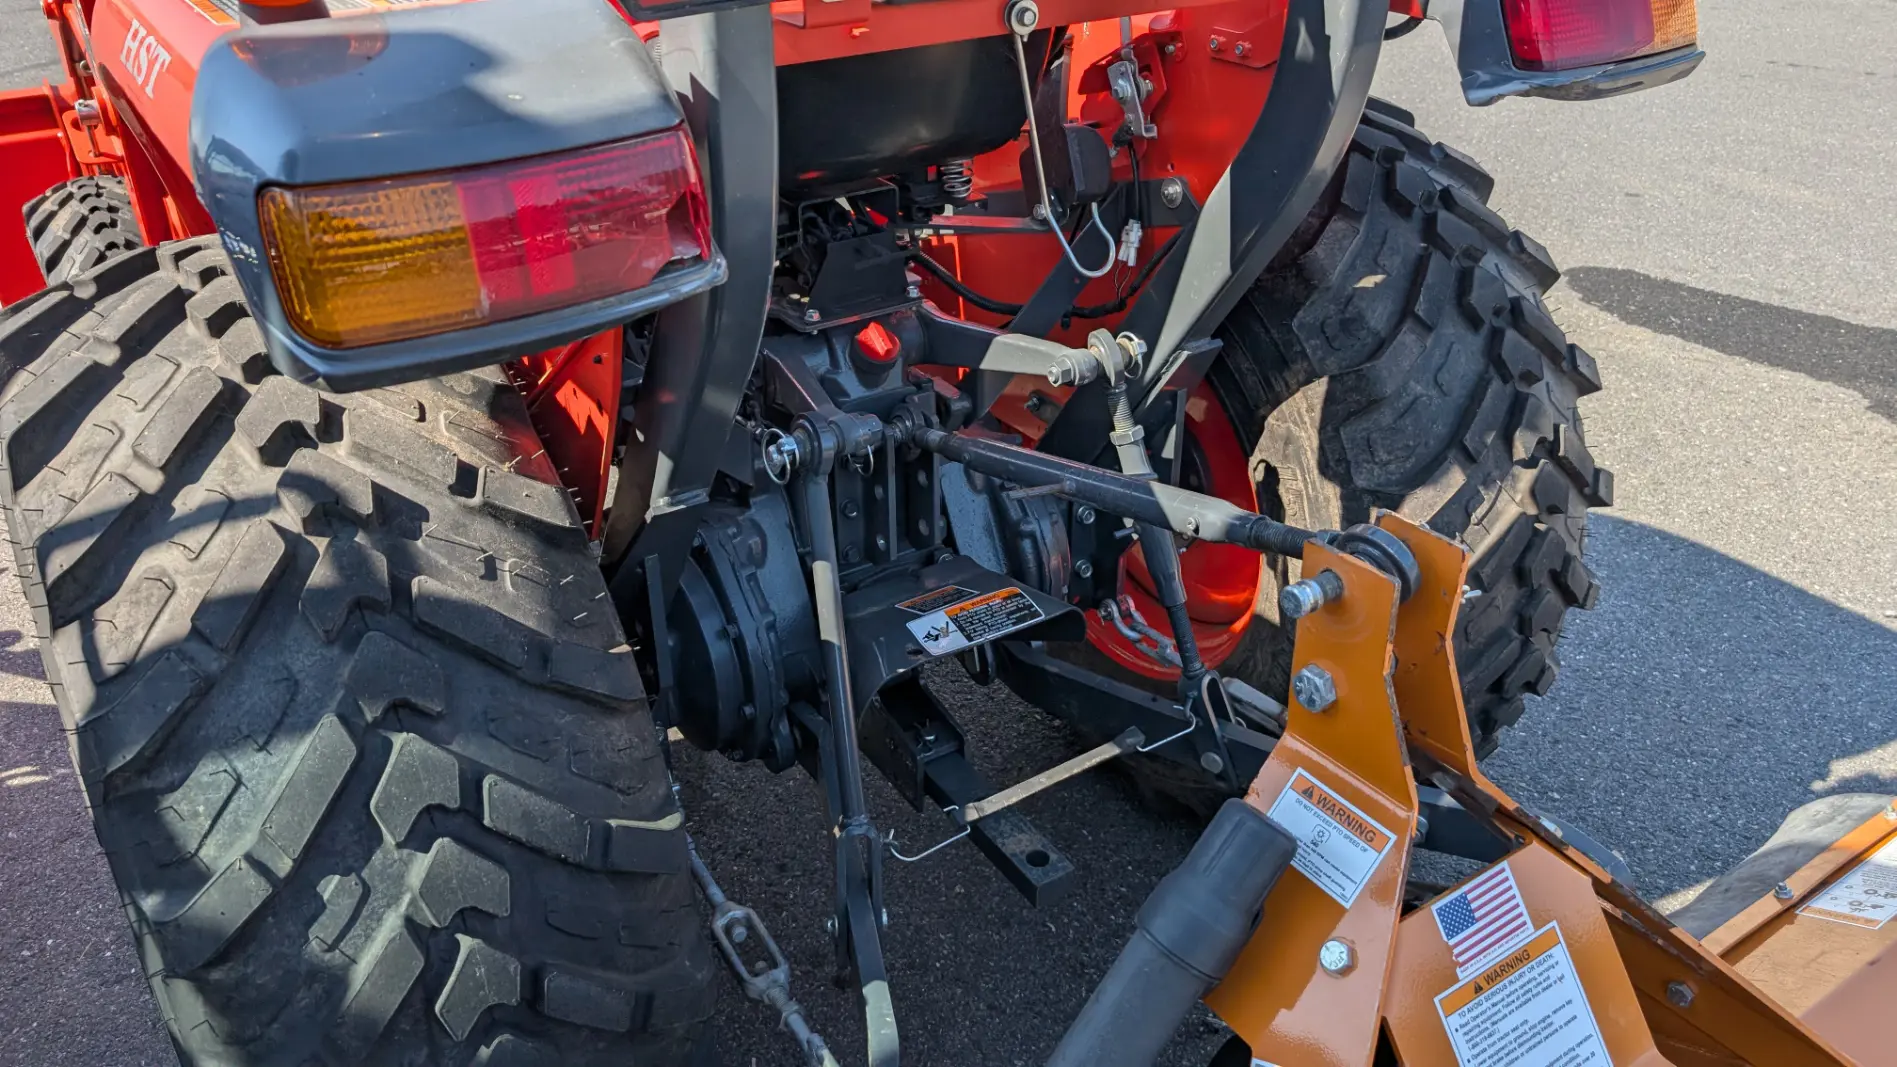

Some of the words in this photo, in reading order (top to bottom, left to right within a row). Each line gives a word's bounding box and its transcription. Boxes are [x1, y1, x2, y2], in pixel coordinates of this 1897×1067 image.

[120, 18, 172, 100] HST
[970, 592, 1000, 607] WARNING
[1294, 797, 1303, 806] DO
[1302, 803, 1313, 813] NOT
[1312, 810, 1333, 828] EXCEED
[1331, 824, 1344, 836] PTO
[1342, 833, 1360, 848] SPEED
[1358, 845, 1368, 854] OF
[1314, 793, 1378, 843] WARNING
[1457, 1009, 1466, 1019] TO
[1465, 998, 1483, 1014] AVOID
[1483, 982, 1508, 1002] SERIOUS
[1506, 969, 1526, 987] INJURY
[1525, 963, 1536, 974] OR
[1483, 948, 1531, 986] WARNING
